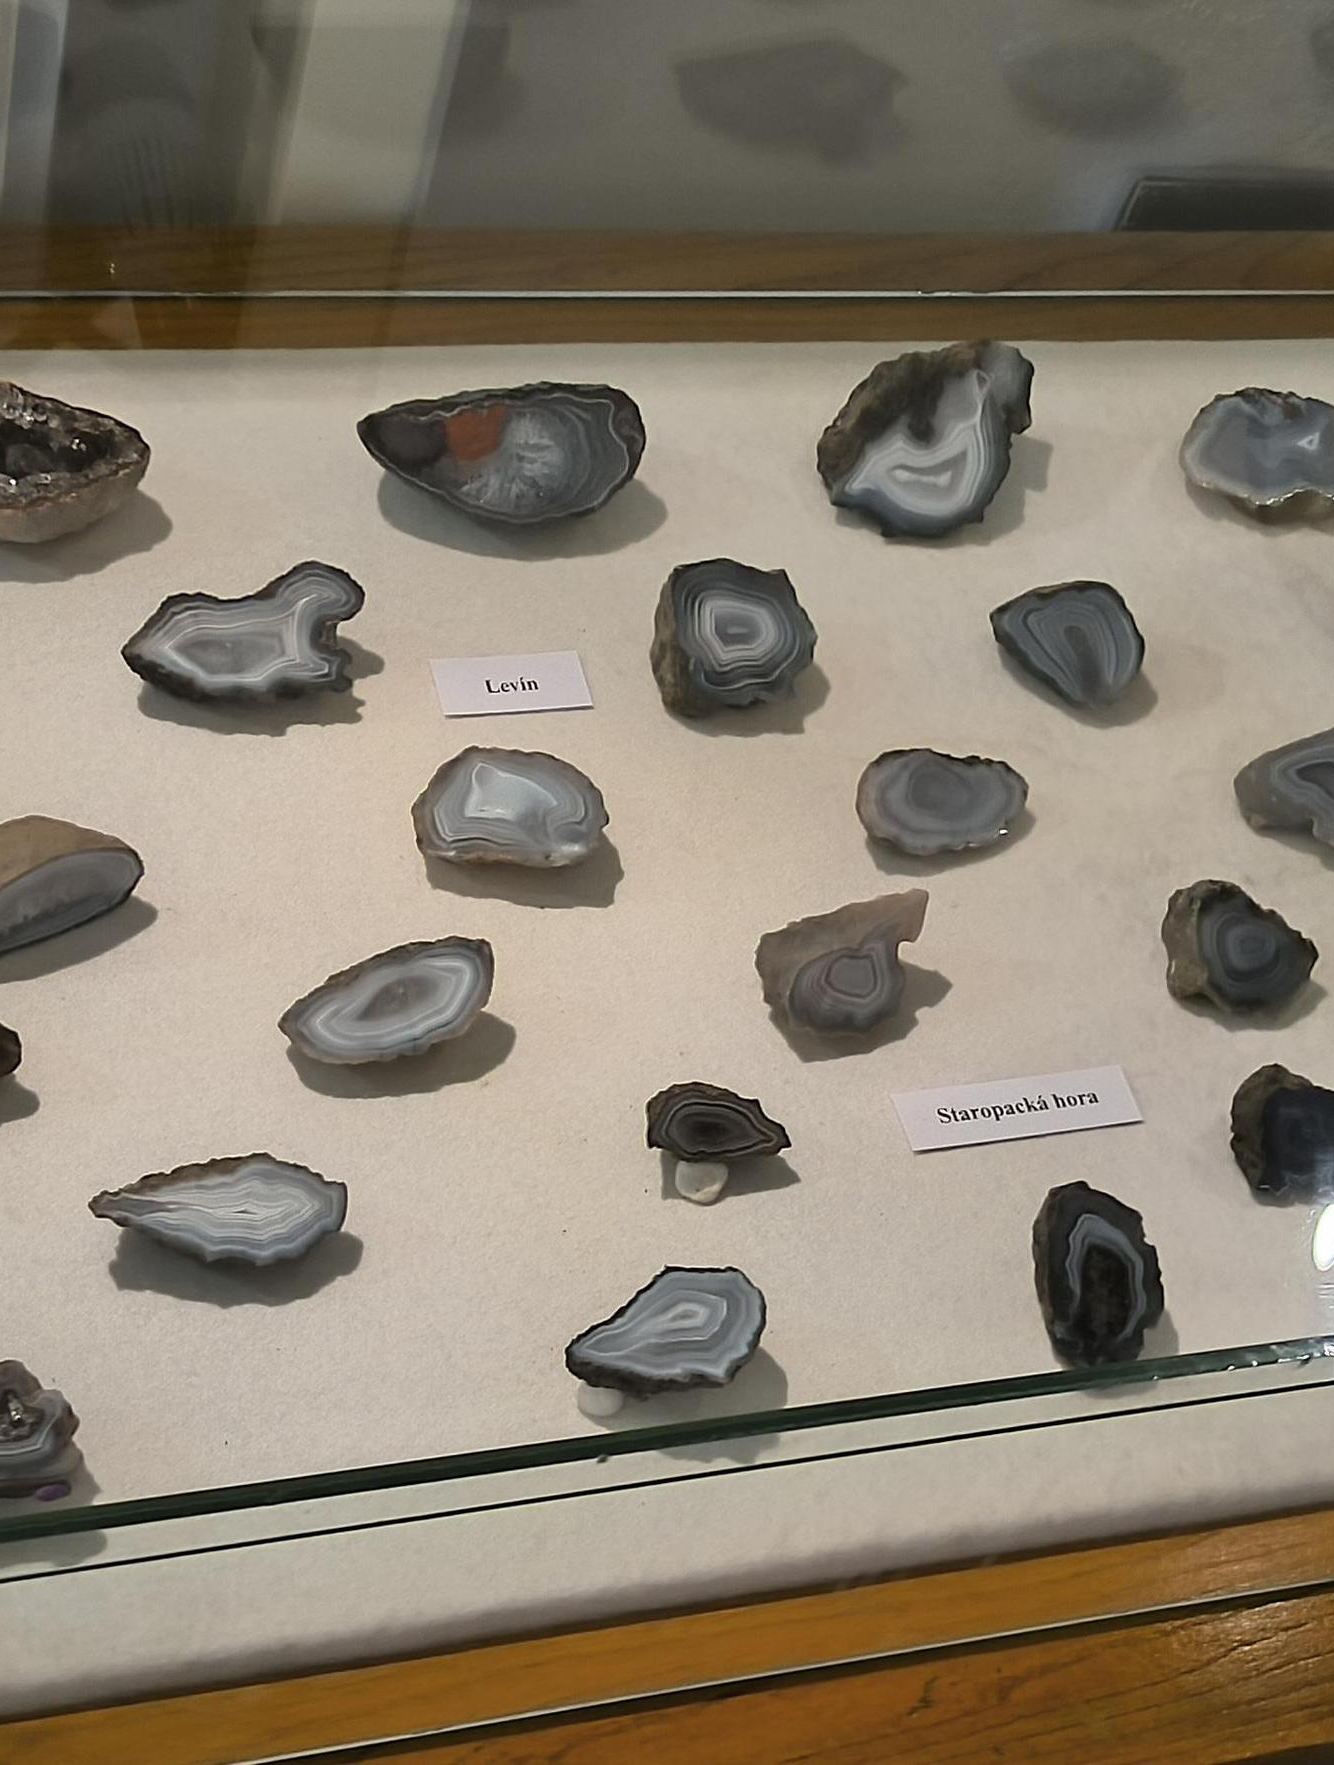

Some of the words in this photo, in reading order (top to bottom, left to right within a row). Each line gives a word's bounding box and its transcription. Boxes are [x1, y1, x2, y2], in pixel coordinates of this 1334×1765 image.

[485, 677, 539, 693] Levín
[937, 1094, 1049, 1124] Staropacká
[1051, 1092, 1099, 1109] hora
